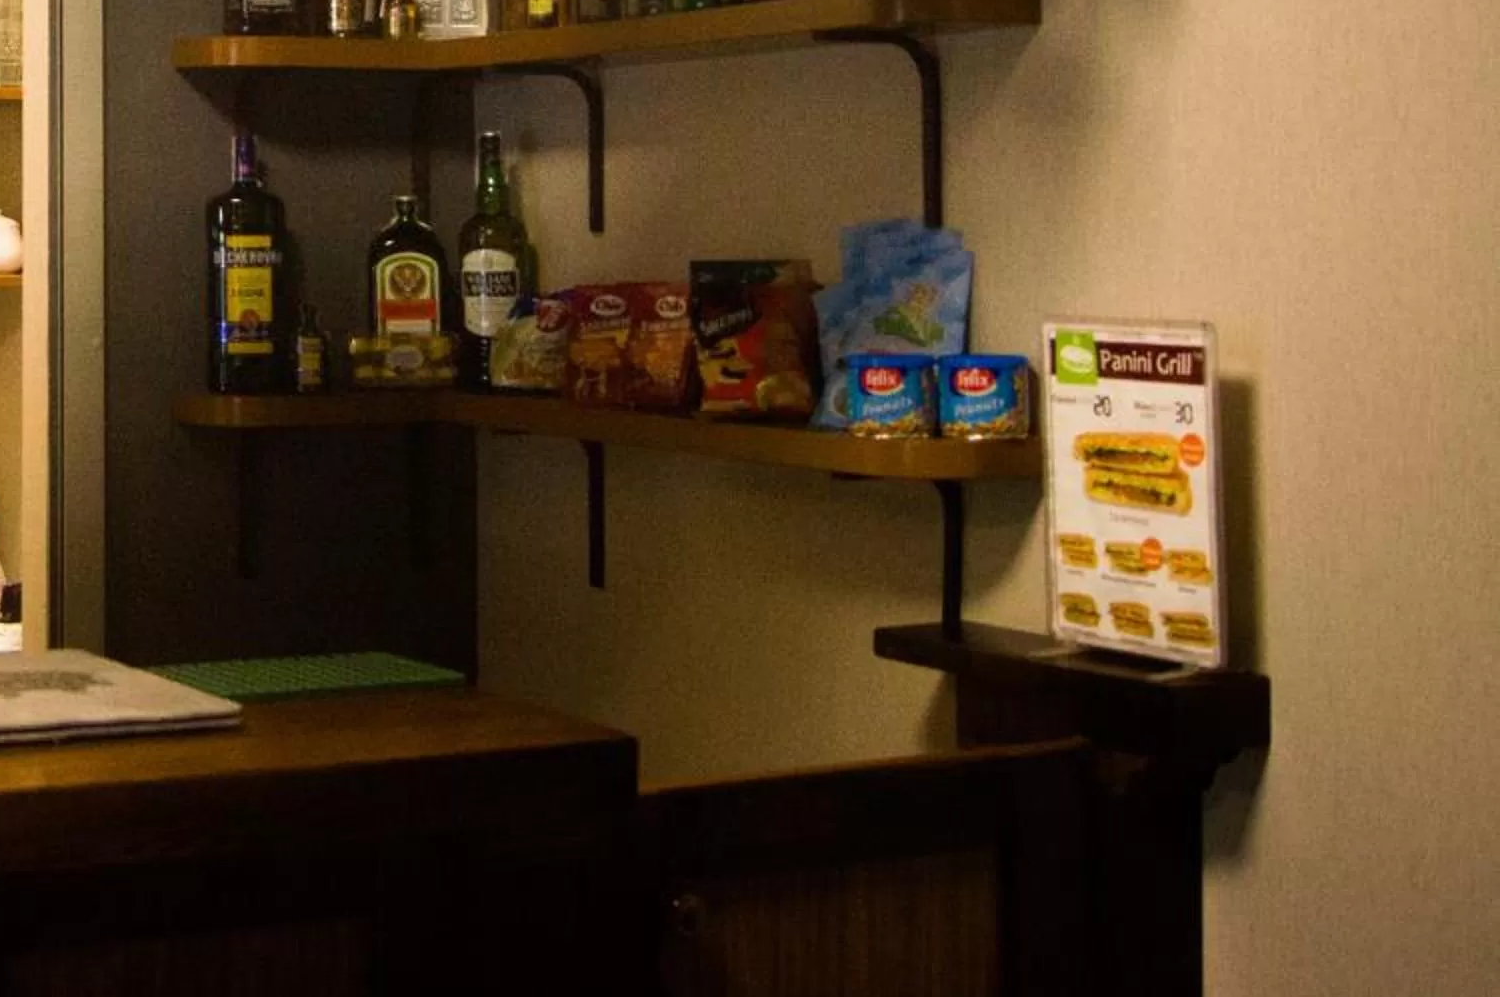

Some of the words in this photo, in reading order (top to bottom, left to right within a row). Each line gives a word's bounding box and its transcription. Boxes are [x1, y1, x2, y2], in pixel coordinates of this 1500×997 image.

[1100, 350, 1152, 373] Panini
[1156, 352, 1193, 375] Grill
[957, 368, 990, 389] felix
[1094, 395, 1112, 417] 20
[1175, 401, 1193, 424] 30
